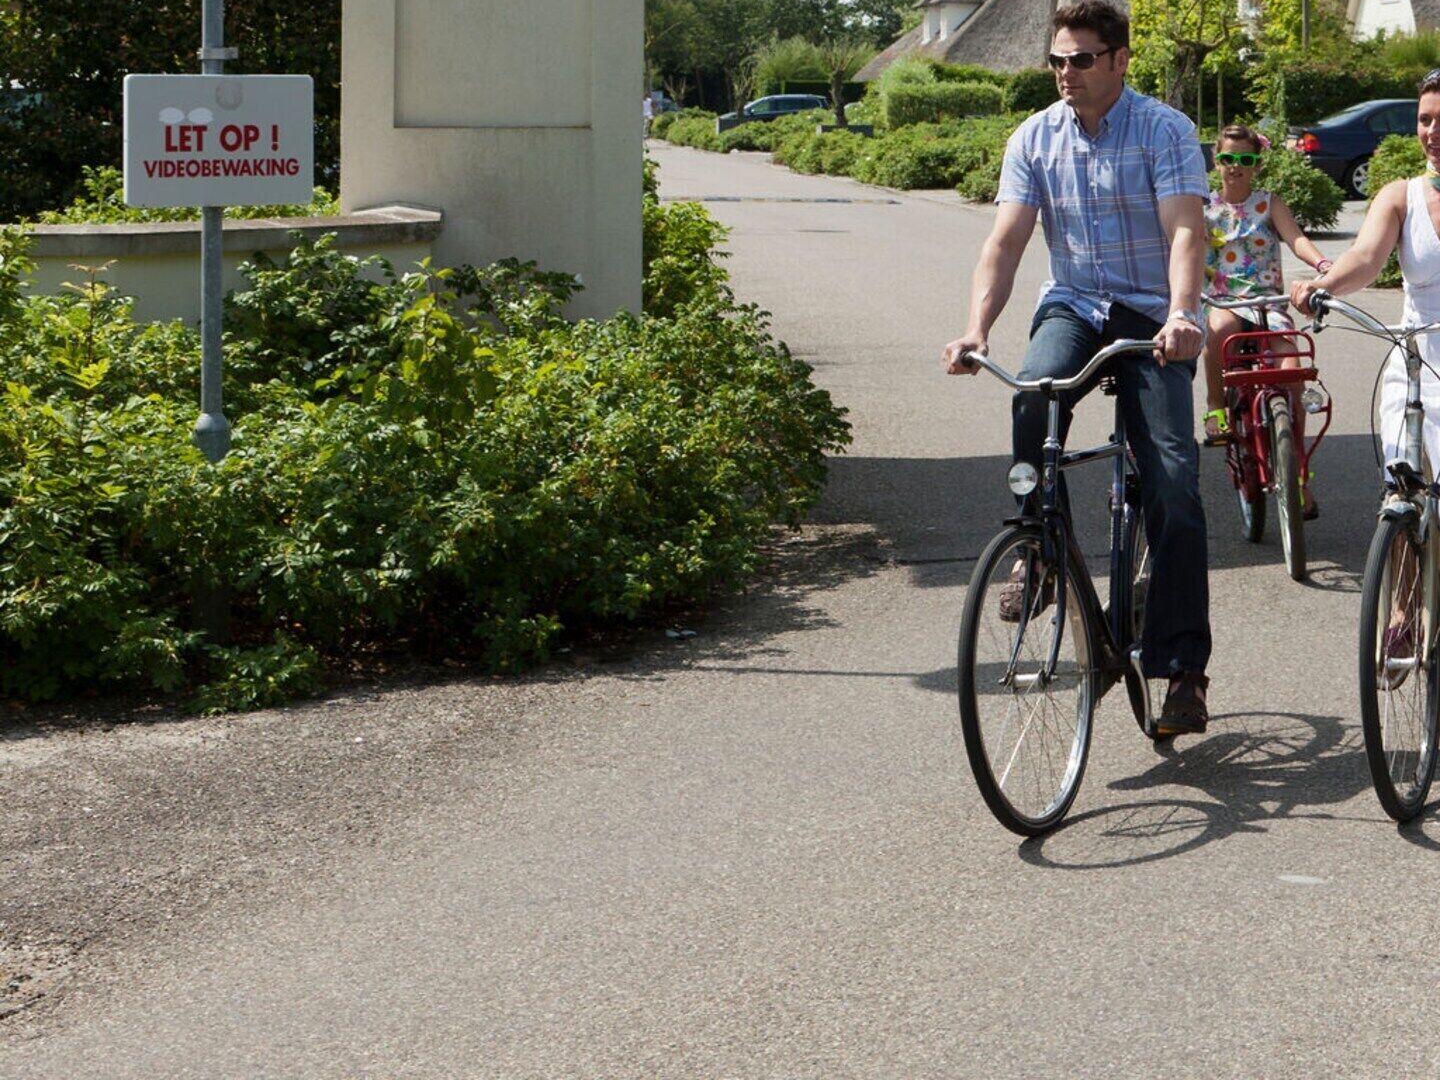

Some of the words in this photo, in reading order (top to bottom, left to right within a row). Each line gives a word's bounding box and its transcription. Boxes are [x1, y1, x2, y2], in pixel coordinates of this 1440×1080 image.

[165, 124, 207, 152] LET
[220, 124, 259, 152] OP
[271, 124, 279, 151] !
[144, 158, 300, 178] VIDEOBEWAKING
